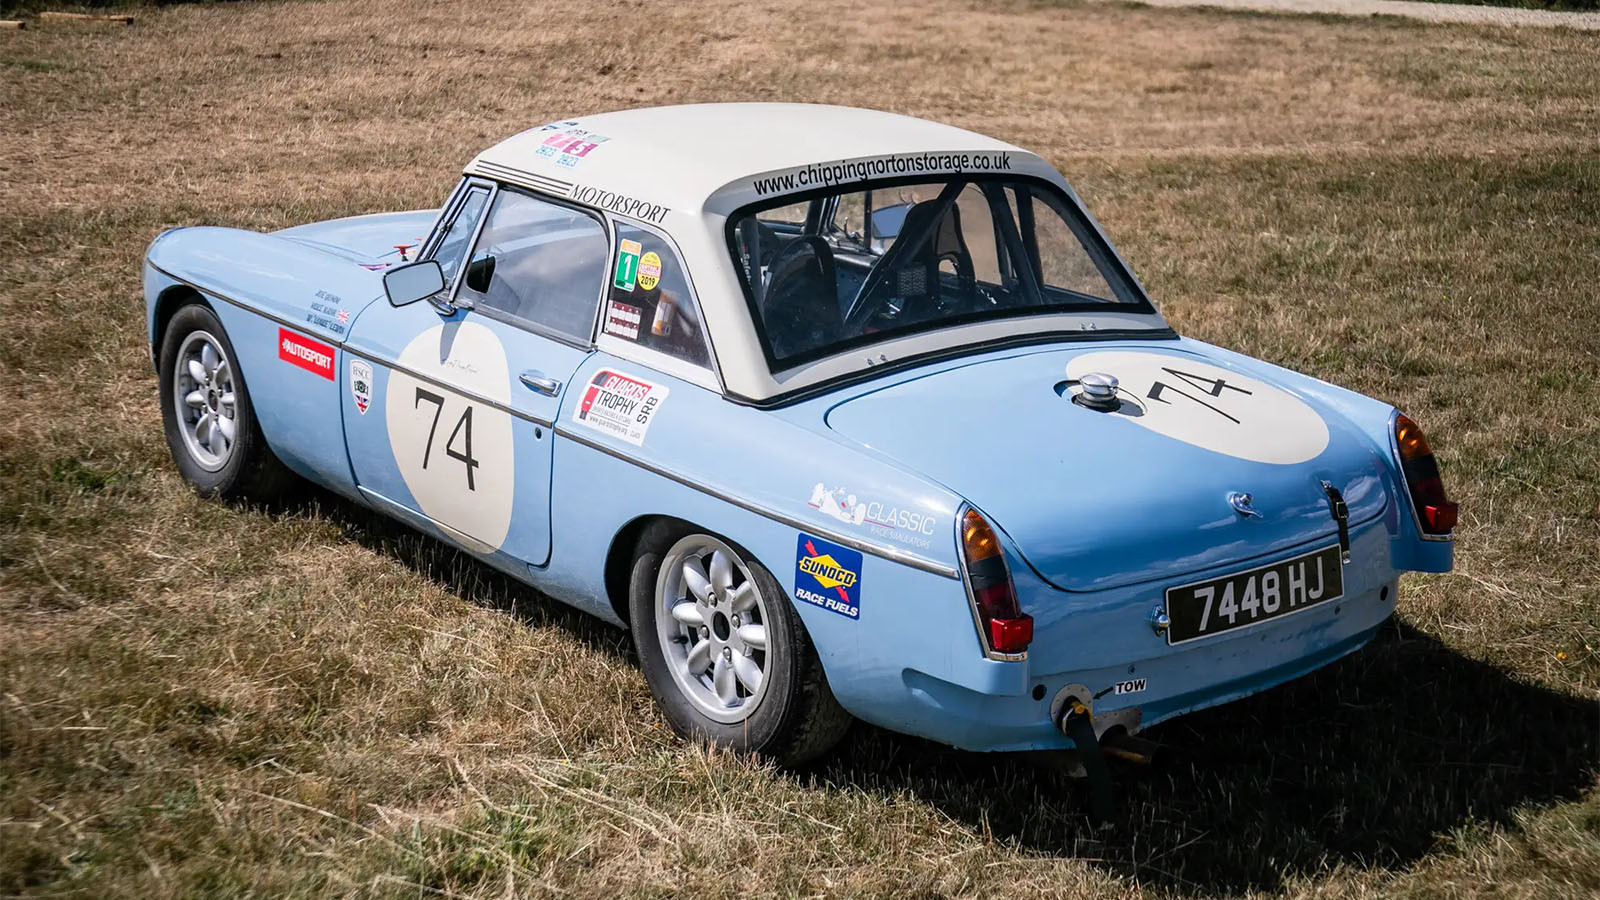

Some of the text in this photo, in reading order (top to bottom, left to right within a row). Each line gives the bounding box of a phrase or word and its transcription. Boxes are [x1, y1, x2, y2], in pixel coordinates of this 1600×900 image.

[753, 151, 1011, 196] www.chippingnortonstorage.co.uk
[570, 184, 671, 223] MOTORSPORT
[624, 254, 633, 281] 1
[640, 274, 656, 287] 2019
[286, 341, 332, 370] AUTOSPORT
[597, 390, 638, 415] TROPHY
[606, 376, 649, 401] GUARDS
[1146, 367, 1253, 425] 74
[636, 396, 659, 424] SRB
[415, 387, 479, 491] 74
[866, 502, 936, 535] CLASSIC
[801, 558, 855, 585] SUNOCO
[796, 587, 859, 617] RACE FUELS
[1194, 556, 1325, 631] 7448 HJ
[1116, 679, 1146, 693] TOW
